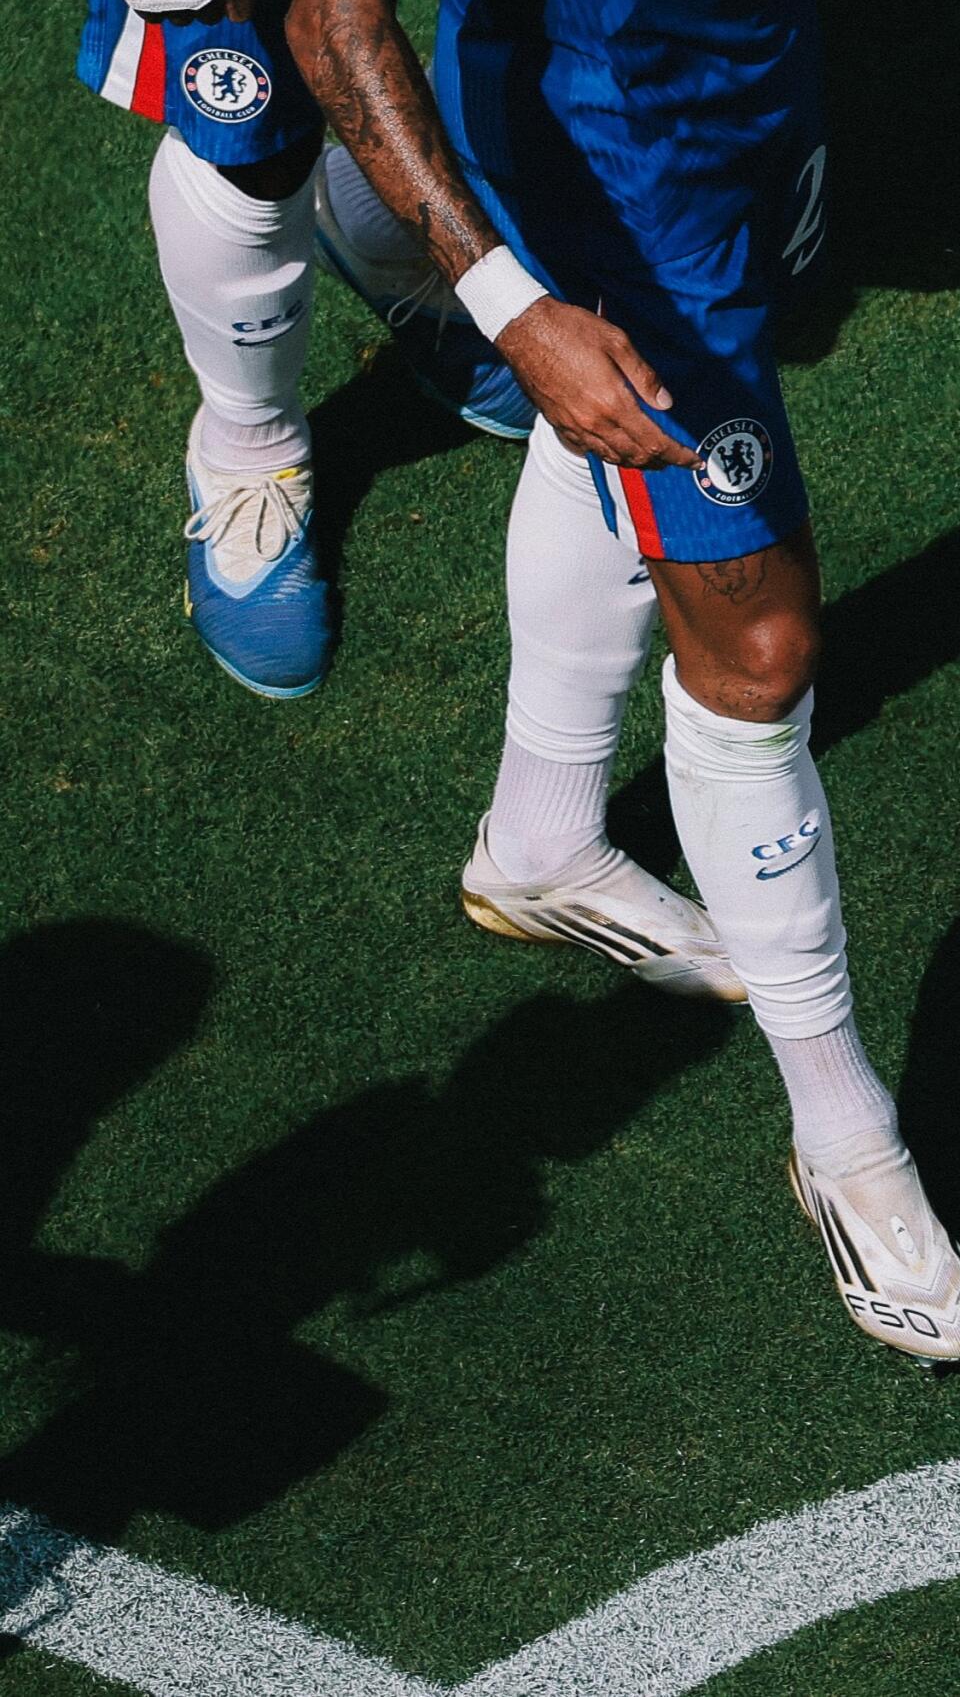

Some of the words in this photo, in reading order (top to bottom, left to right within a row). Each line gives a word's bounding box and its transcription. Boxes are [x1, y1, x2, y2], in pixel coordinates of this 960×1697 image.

[198, 52, 254, 70] CHELSEA
[197, 100, 233, 118] FOOTBALL
[236, 106, 256, 117] CLUB
[703, 422, 755, 450] CHELSEA
[751, 821, 819, 860] CFC
[845, 1293, 942, 1339] F50
